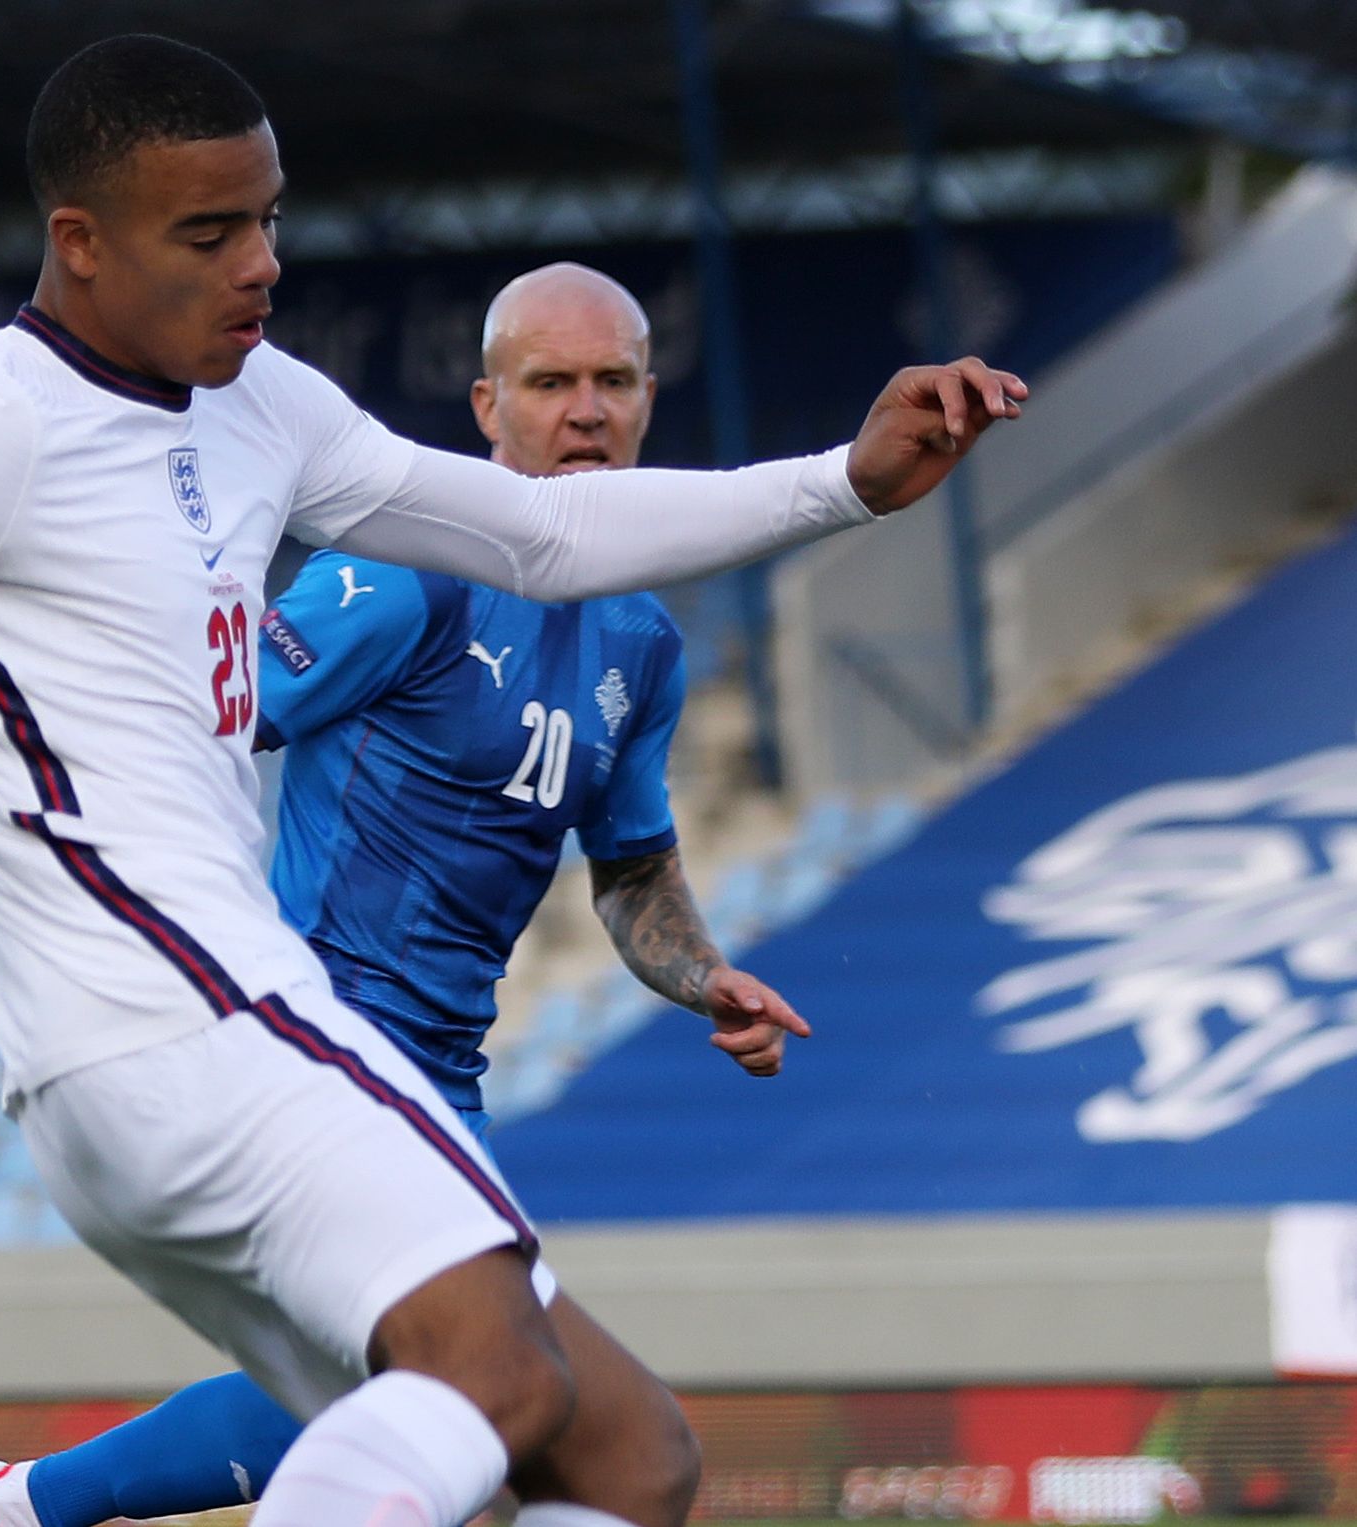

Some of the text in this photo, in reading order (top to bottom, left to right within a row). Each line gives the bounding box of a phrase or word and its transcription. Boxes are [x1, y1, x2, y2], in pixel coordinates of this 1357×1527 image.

[206, 602, 253, 736] 23
[266, 619, 312, 670] ESPECT
[502, 700, 573, 809] 20
